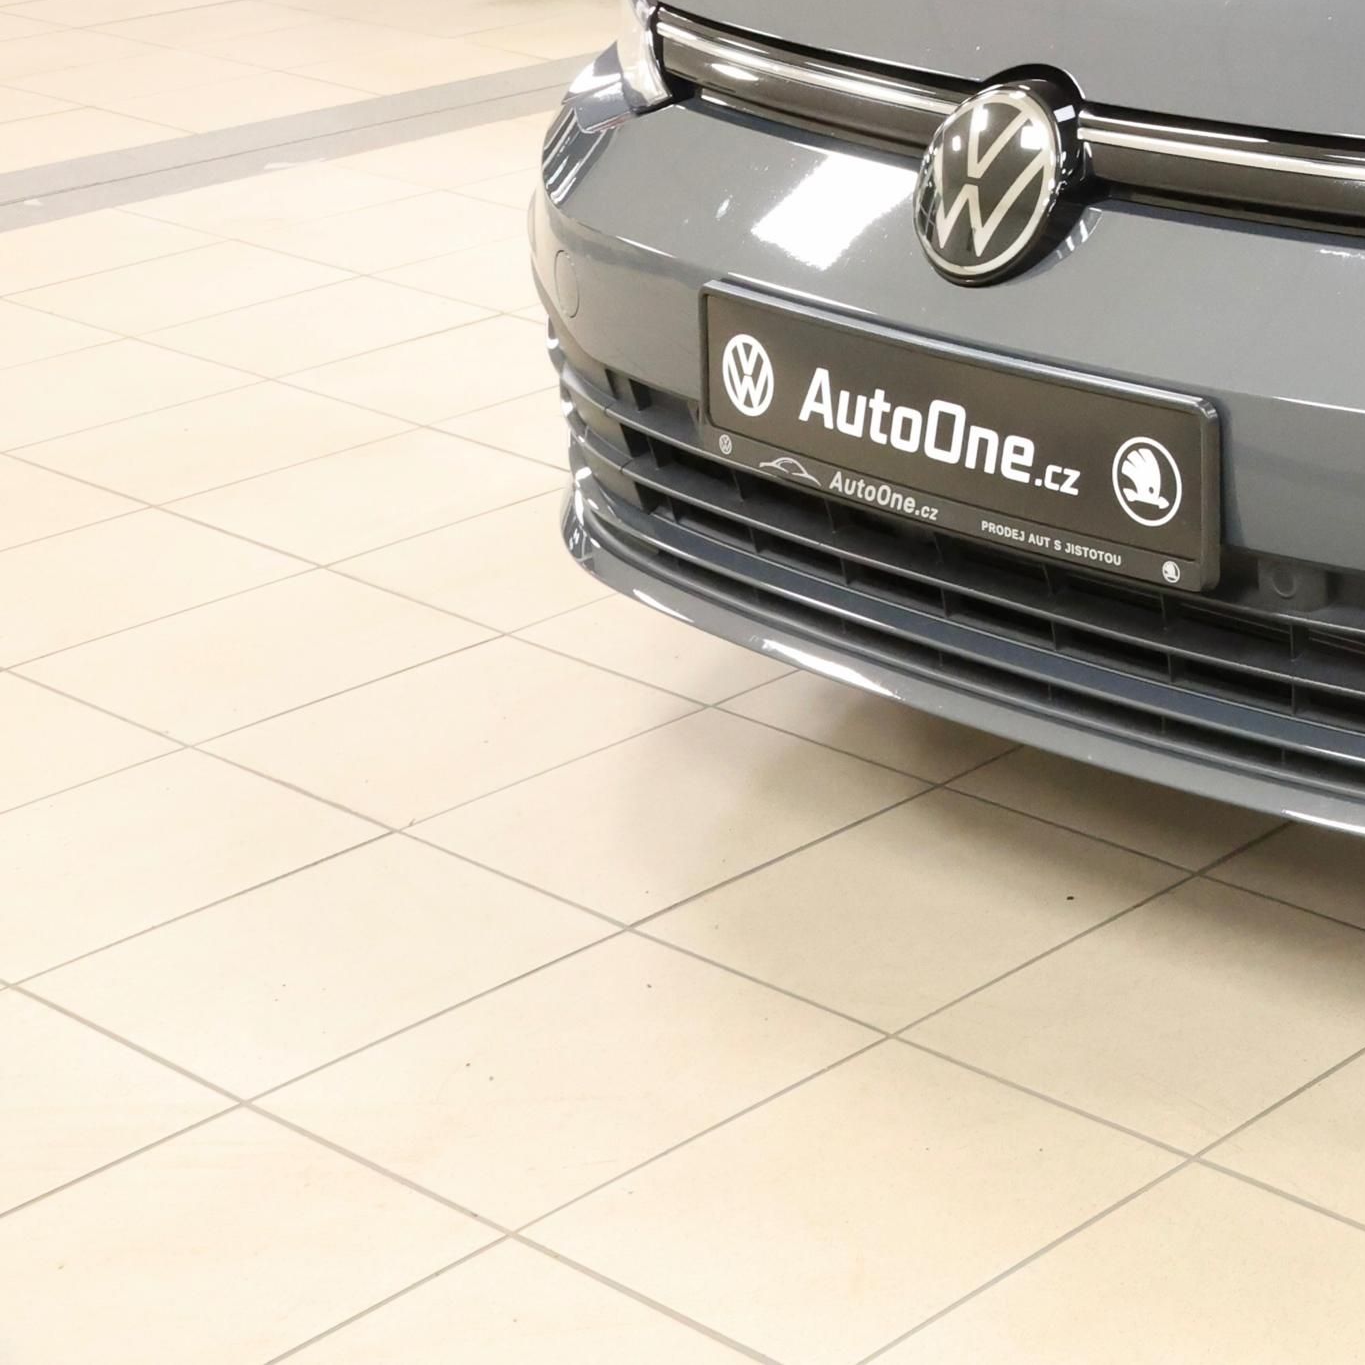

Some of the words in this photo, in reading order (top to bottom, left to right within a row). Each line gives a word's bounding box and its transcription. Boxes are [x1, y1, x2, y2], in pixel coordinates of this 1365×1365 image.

[798, 366, 1082, 496] AutoOne.cz
[828, 470, 940, 522] AutoOne.cz
[980, 519, 1026, 542] PRODEJ
[1028, 533, 1051, 549] AUT
[1053, 539, 1062, 552] S
[1064, 542, 1122, 567] JISTOTOU
